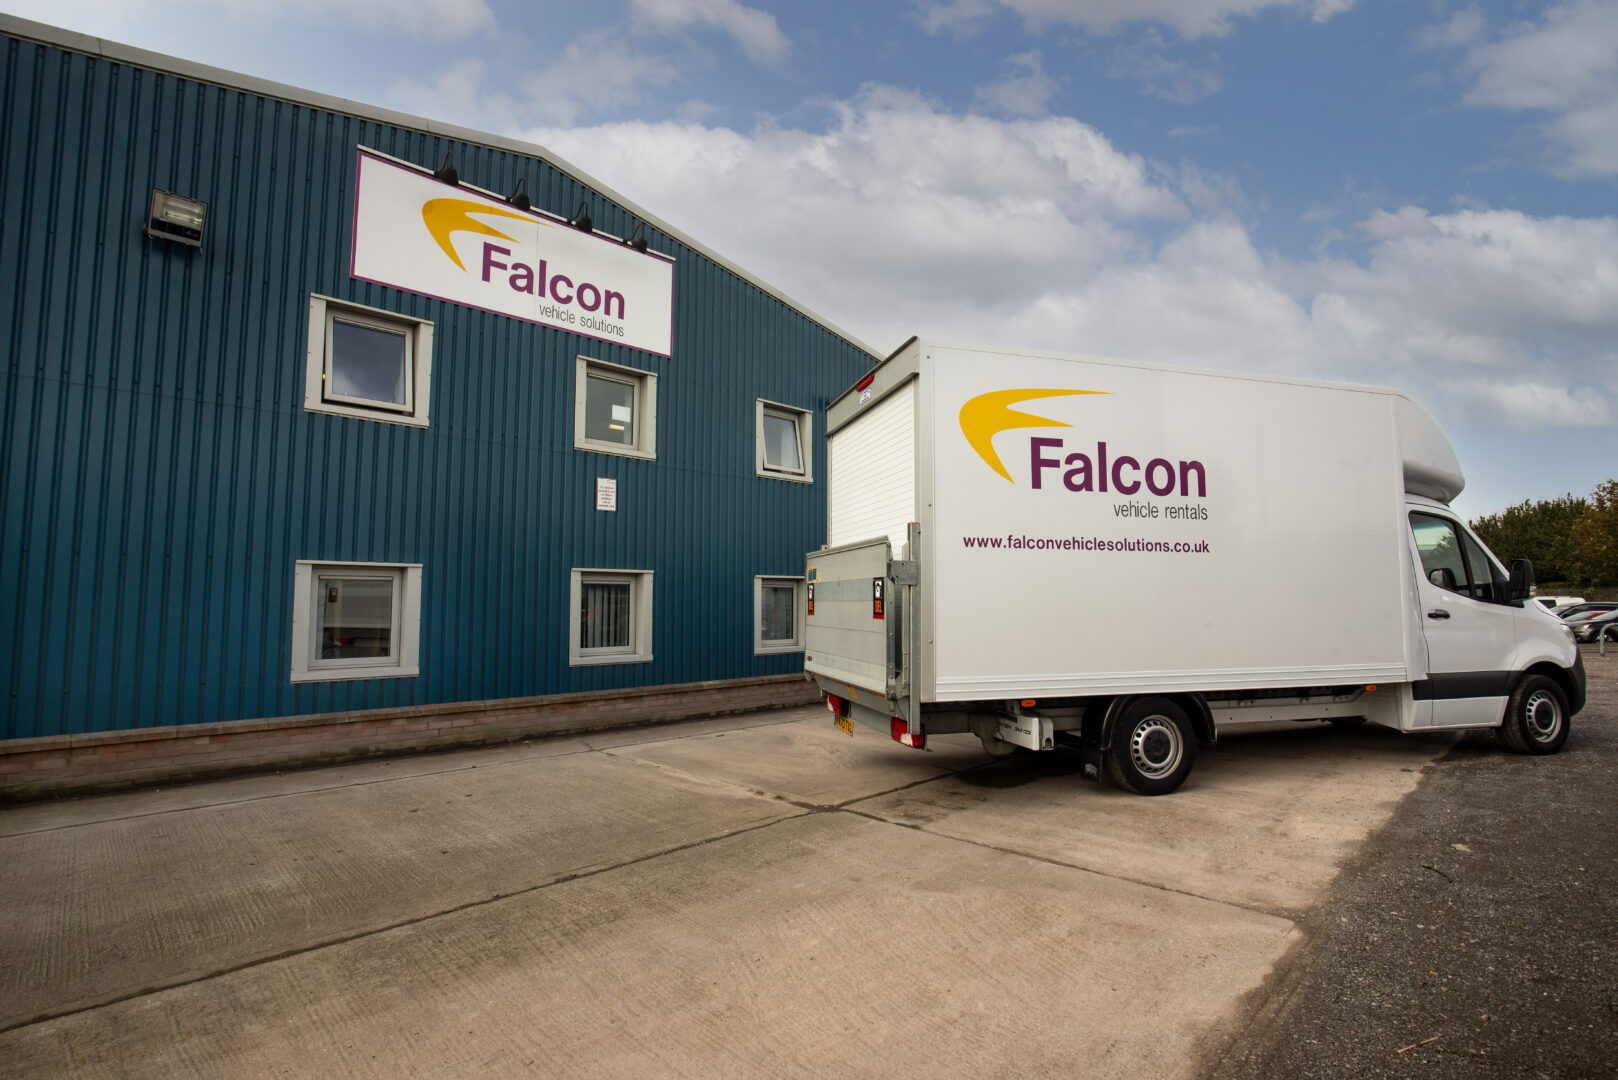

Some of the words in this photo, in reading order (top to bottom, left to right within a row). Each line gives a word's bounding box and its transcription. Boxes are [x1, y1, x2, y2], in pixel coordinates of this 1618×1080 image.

[481, 241, 625, 320] Falcon
[539, 304, 576, 324] vehicle
[579, 316, 624, 337] solutions
[1030, 436, 1207, 498] Falcon
[1113, 500, 1159, 519] vehicle
[1164, 503, 1209, 520] rentals
[963, 534, 1211, 554] www.falconvehiclesolutions.co.uk
